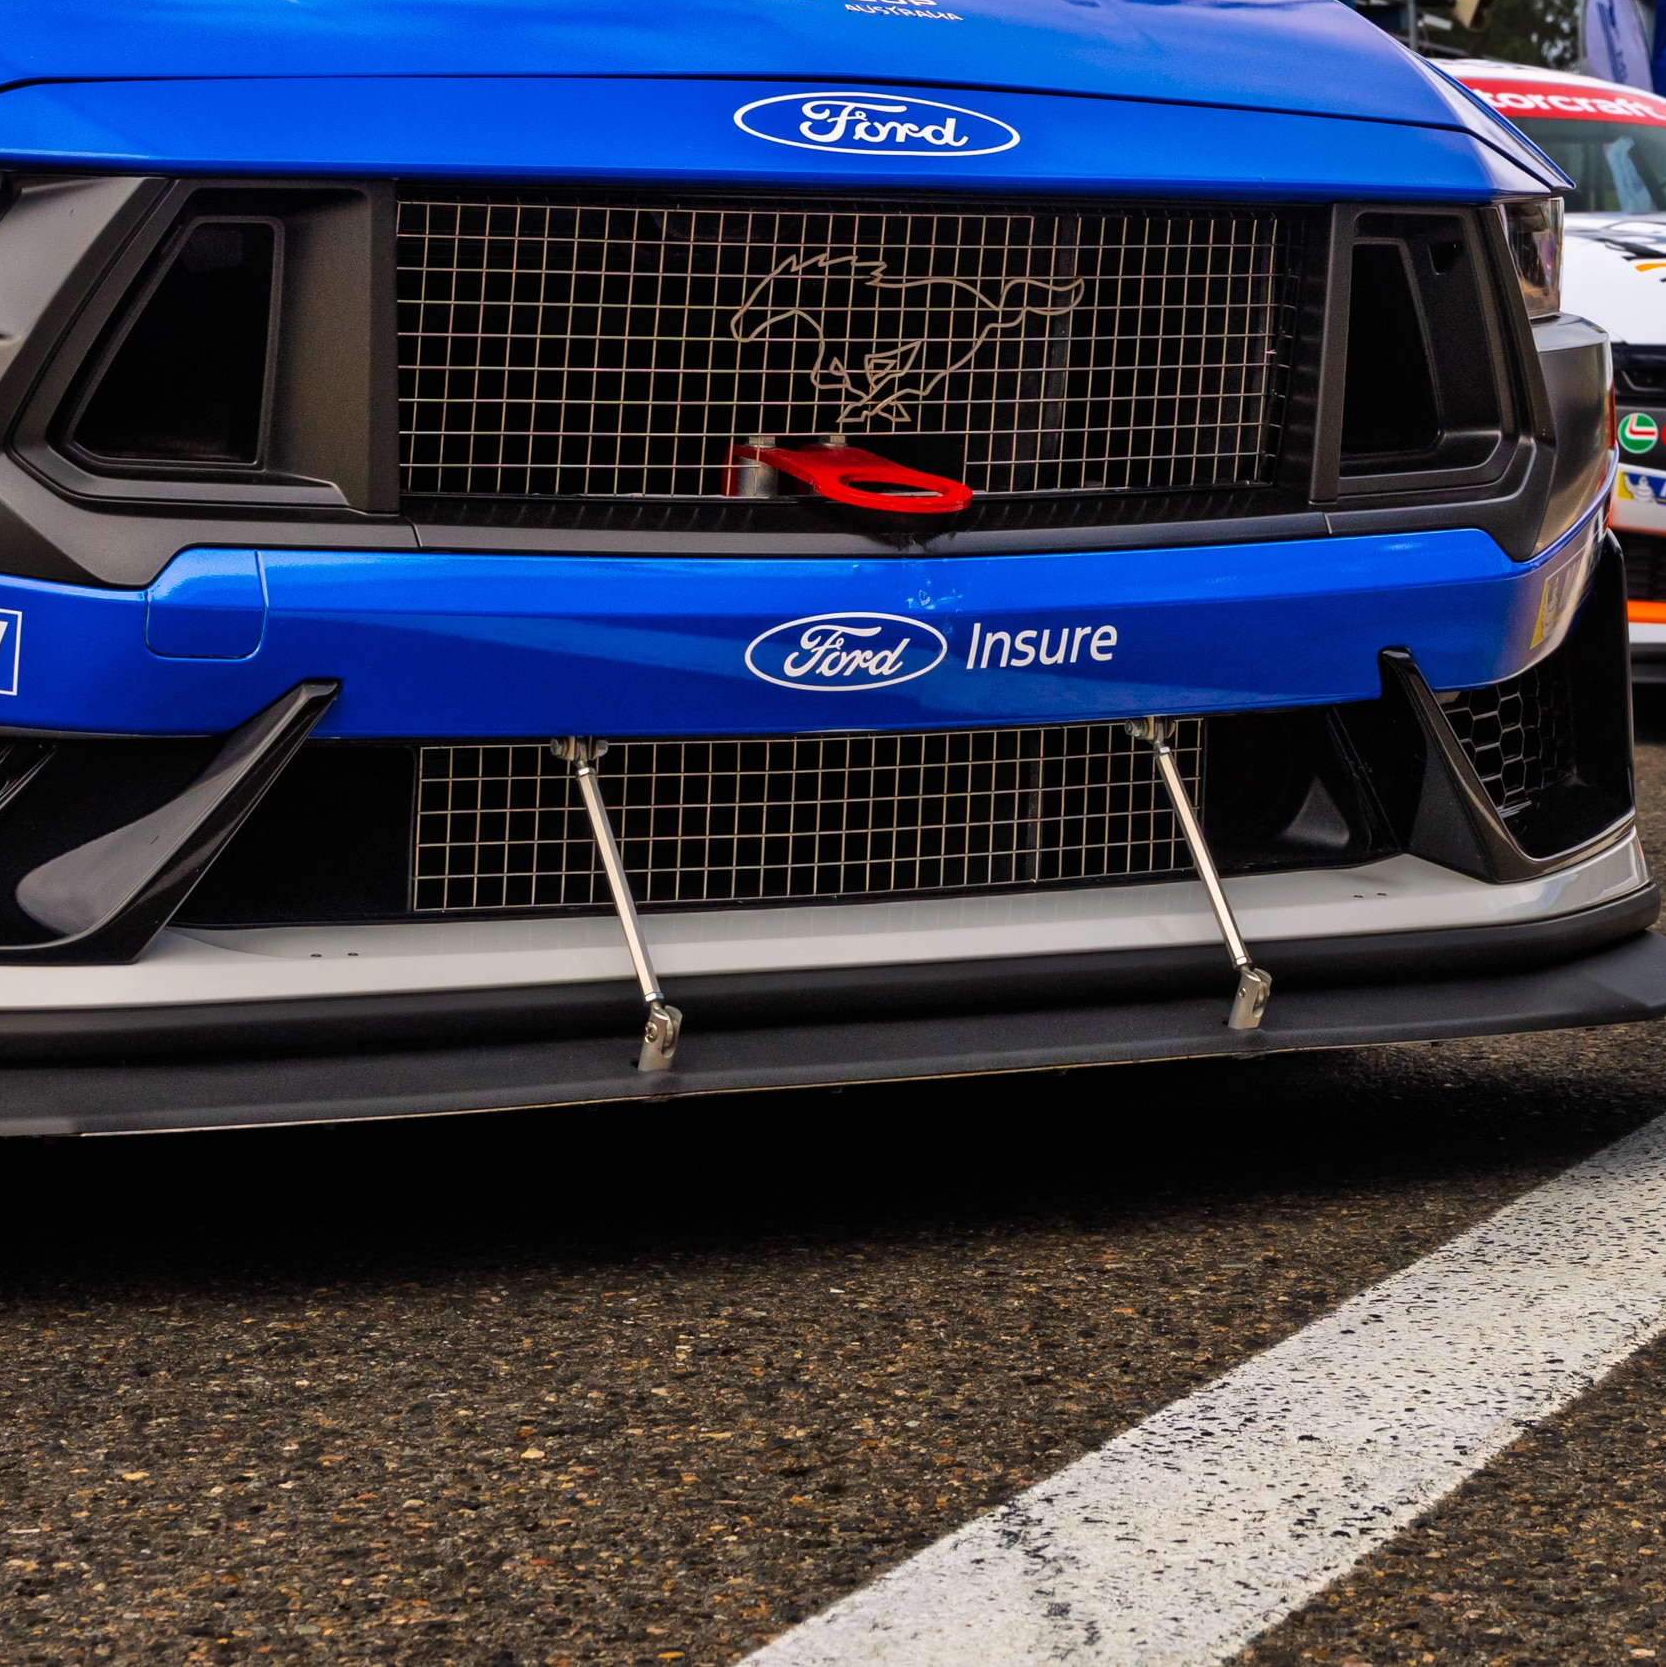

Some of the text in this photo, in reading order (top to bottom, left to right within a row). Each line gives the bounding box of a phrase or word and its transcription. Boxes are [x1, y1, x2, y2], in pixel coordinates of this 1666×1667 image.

[800, 101, 969, 148] Ford
[784, 621, 1116, 677] Ford Insure
